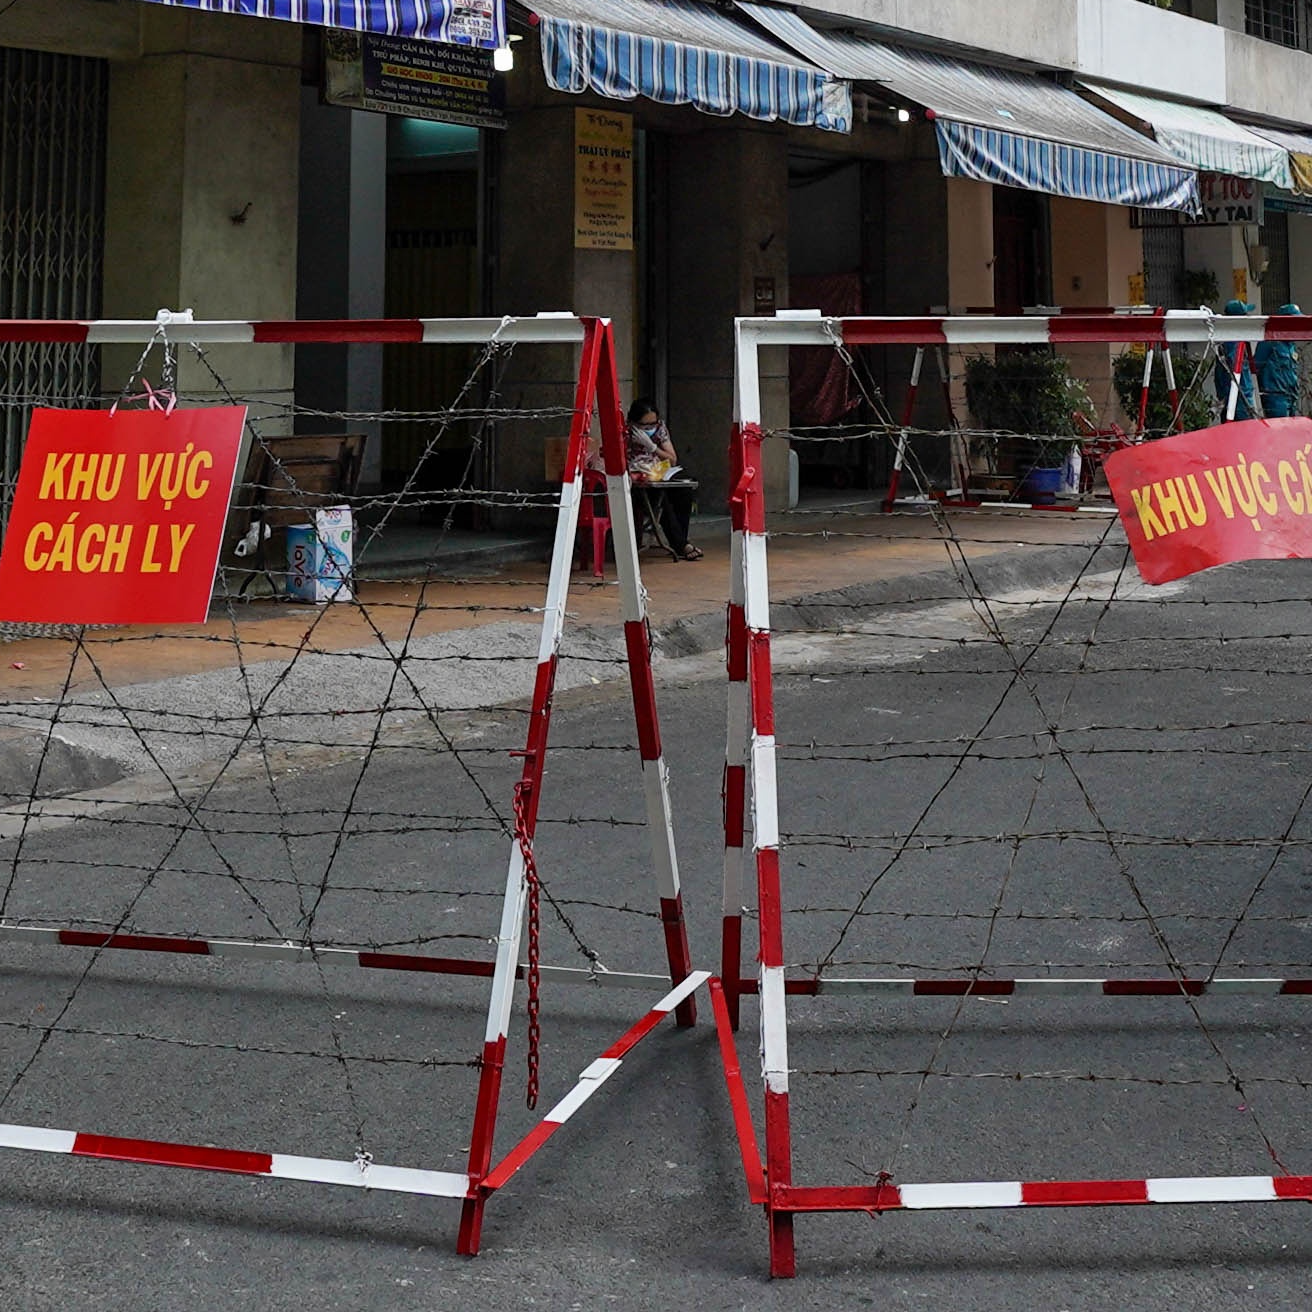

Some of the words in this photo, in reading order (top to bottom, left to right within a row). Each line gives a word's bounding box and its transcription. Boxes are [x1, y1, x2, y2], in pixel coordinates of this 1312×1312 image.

[38, 452, 126, 502] KHU
[137, 442, 214, 511] VỰC
[1131, 473, 1208, 541] KHU
[1204, 452, 1279, 532] VỰC
[23, 511, 134, 573] CÁCH
[140, 523, 196, 573] LY
